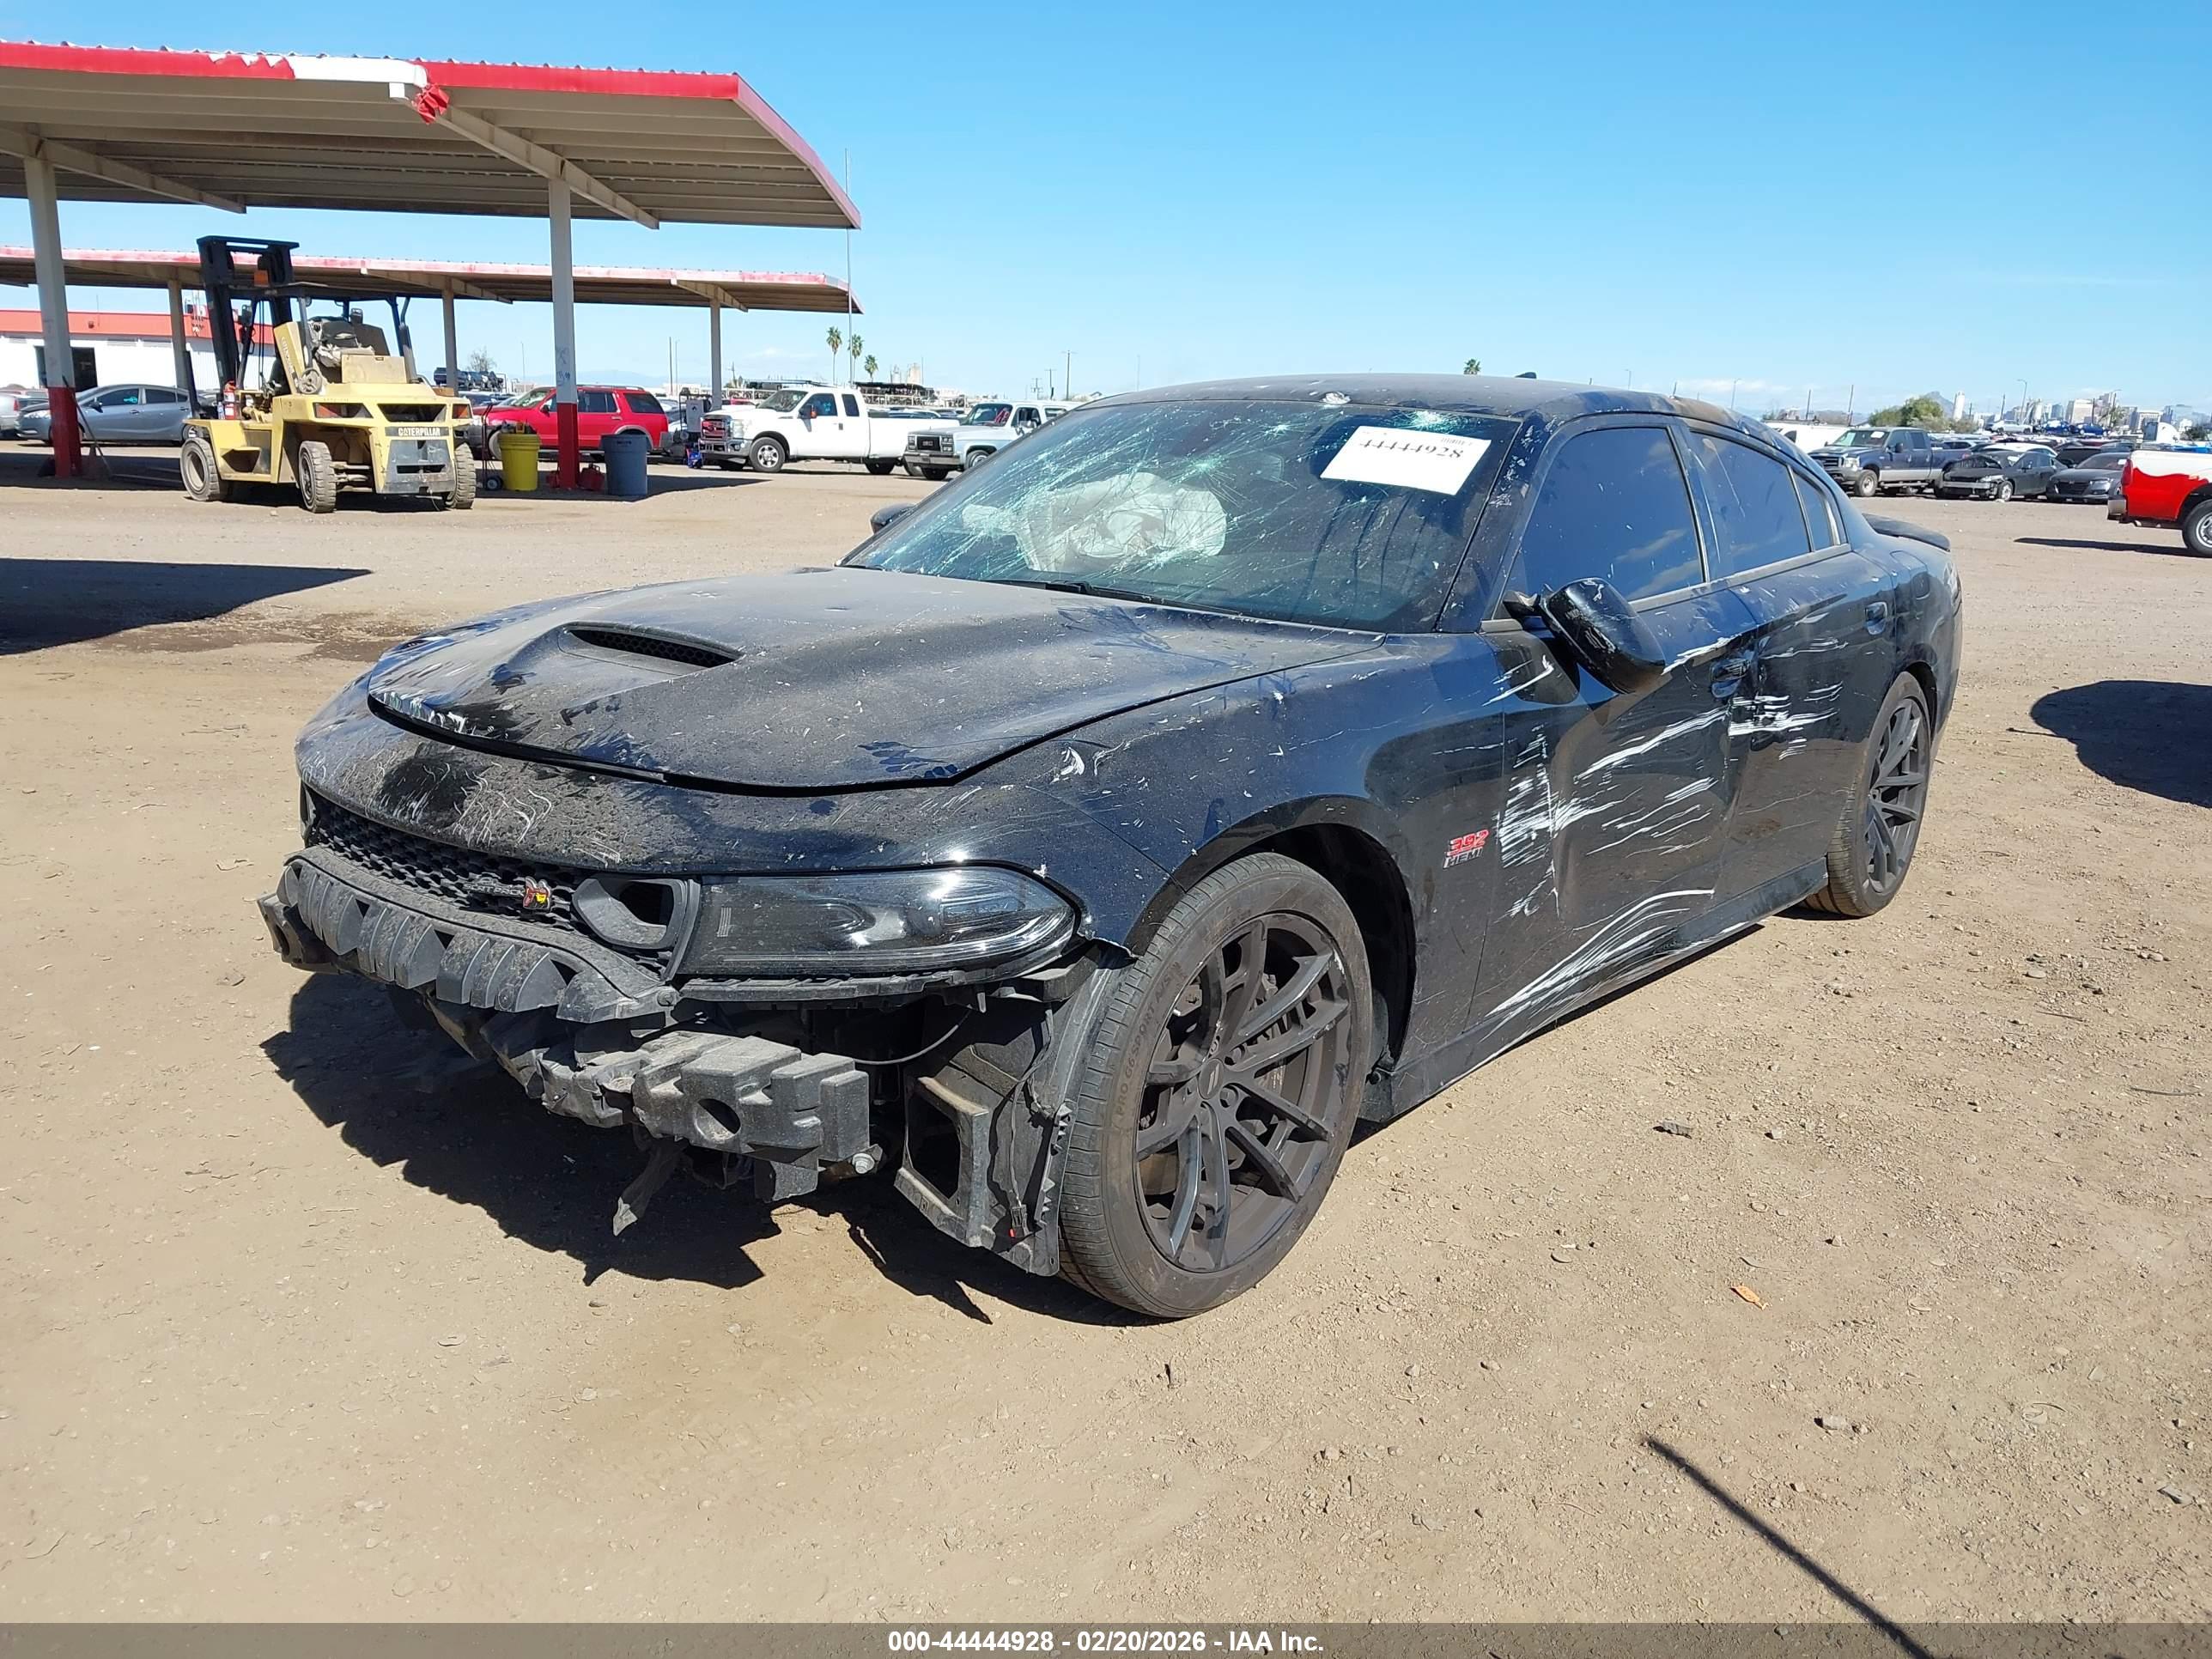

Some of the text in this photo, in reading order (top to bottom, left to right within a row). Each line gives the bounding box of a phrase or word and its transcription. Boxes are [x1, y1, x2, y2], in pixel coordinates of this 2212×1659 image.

[398, 428, 441, 436] CATERPILLAR
[1359, 439, 1464, 459] 44444928
[1449, 830, 1489, 854] 392
[1130, 1002, 1156, 1057] SPORT
